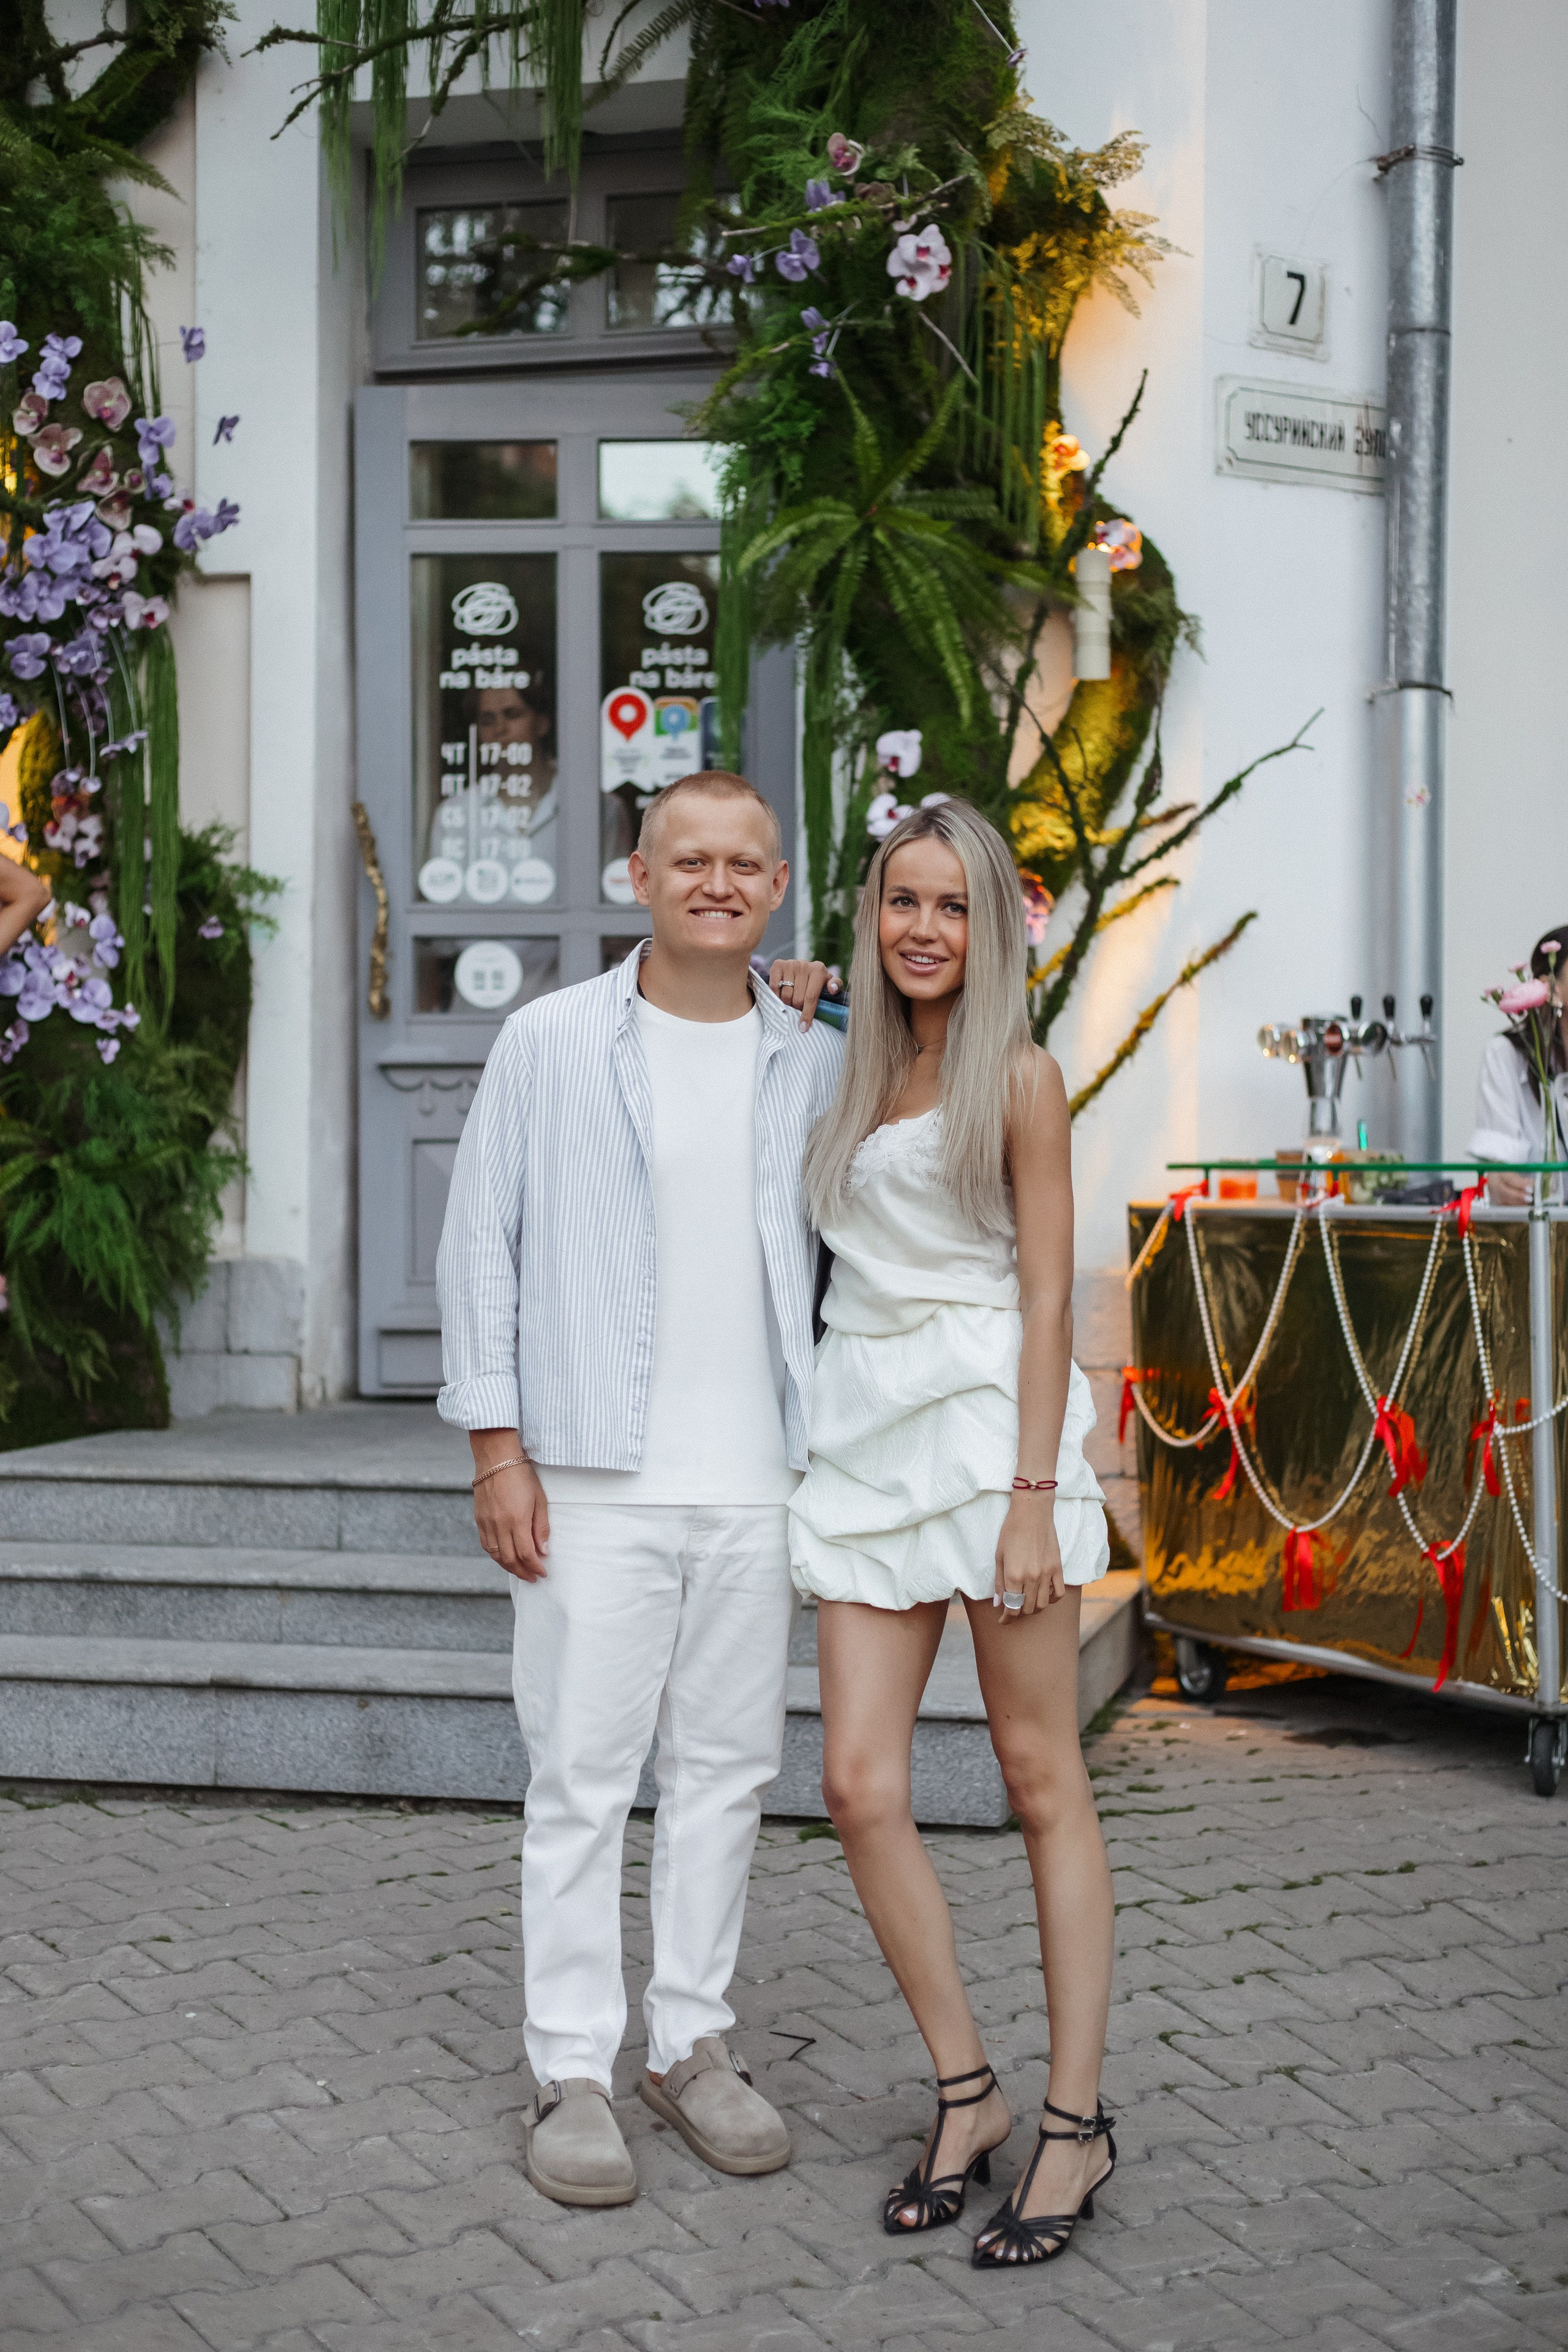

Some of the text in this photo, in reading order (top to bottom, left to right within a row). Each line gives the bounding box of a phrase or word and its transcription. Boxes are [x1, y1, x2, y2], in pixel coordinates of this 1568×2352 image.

[1287, 271, 1305, 325] 7
[439, 671, 471, 690] na
[630, 671, 660, 689] na
